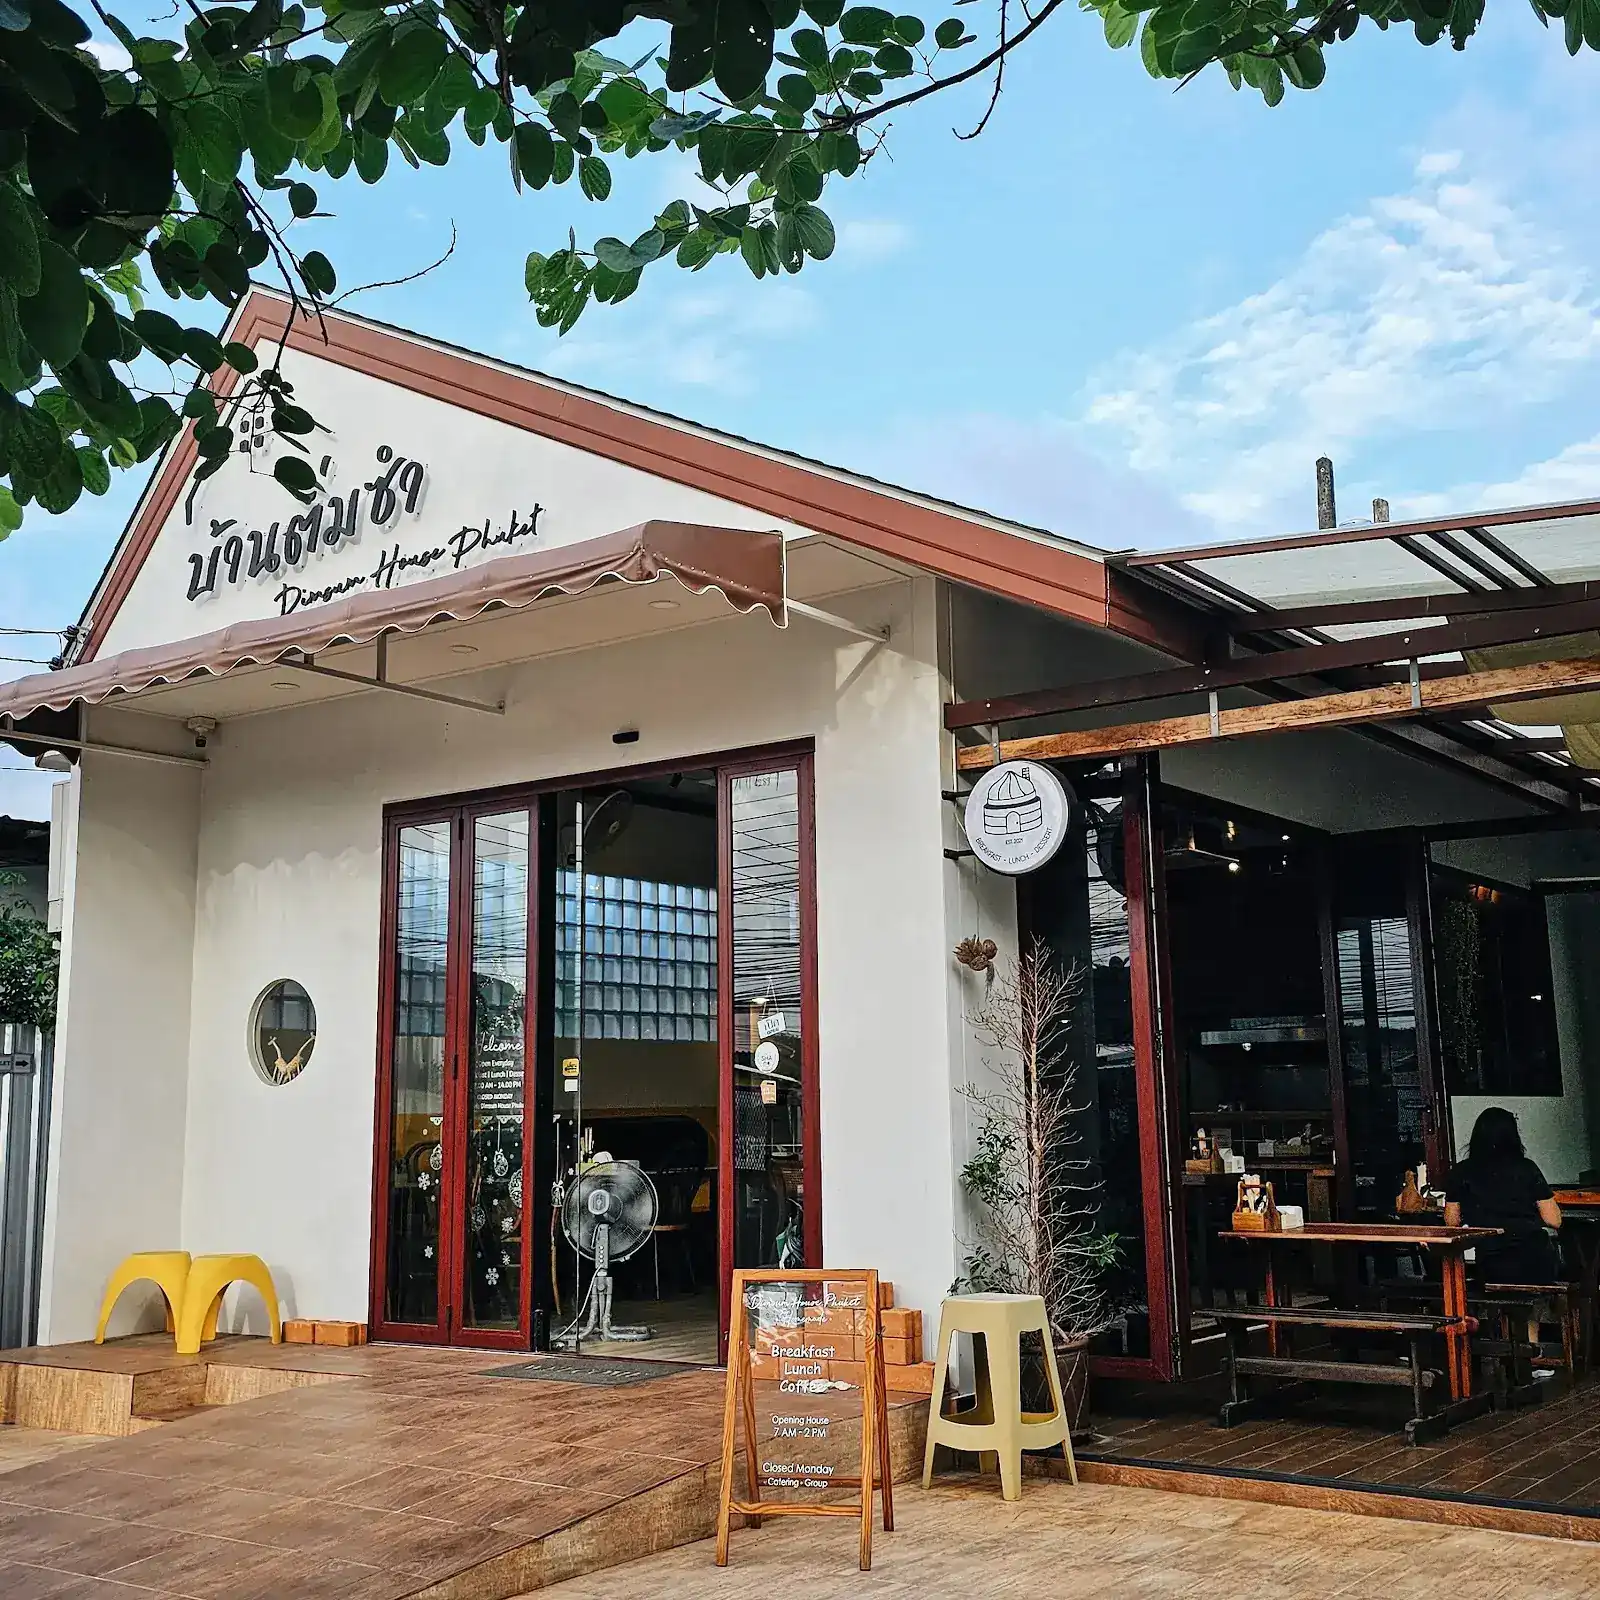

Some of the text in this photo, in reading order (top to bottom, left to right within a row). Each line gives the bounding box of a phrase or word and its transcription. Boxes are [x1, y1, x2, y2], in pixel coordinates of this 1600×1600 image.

[186, 445, 424, 601] บ้านต่มซำ
[370, 543, 446, 589] House
[448, 503, 543, 568] Phuket
[975, 827, 1053, 865] BREAKFAST LUNCH DESSERT
[791, 1293, 822, 1309] House
[823, 1292, 861, 1308] Phuket
[771, 1344, 836, 1358] Breakfast
[784, 1361, 822, 1375] Lunch
[779, 1379, 824, 1394] Coffee
[771, 1415, 830, 1426] Opening House
[773, 1427, 780, 1437] 7
[781, 1427, 797, 1437] AM
[803, 1427, 810, 1438] 2
[811, 1427, 827, 1438] PM
[762, 1462, 835, 1476] Closed Monday
[767, 1477, 828, 1489] Catering Group
